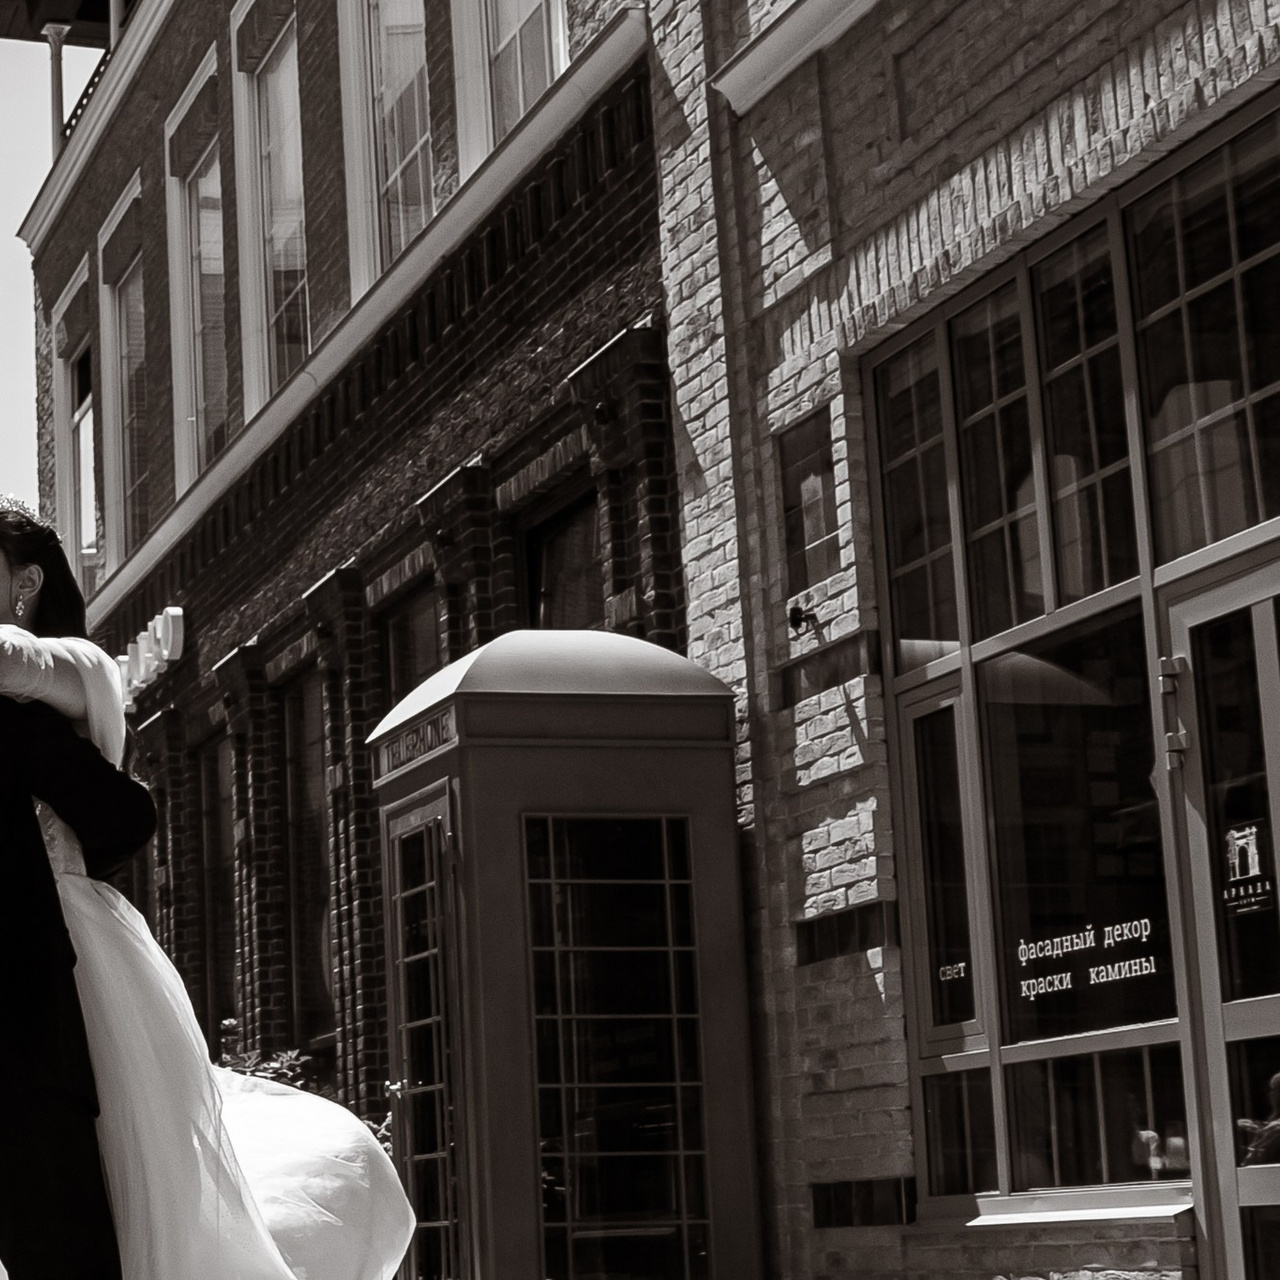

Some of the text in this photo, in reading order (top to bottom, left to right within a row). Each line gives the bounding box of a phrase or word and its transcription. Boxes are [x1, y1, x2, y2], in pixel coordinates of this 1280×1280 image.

[385, 712, 451, 772] TELEPHONE
[1018, 918, 1151, 966] фасадный декор
[939, 962, 966, 981] свет
[1020, 956, 1156, 1001] краски камины
